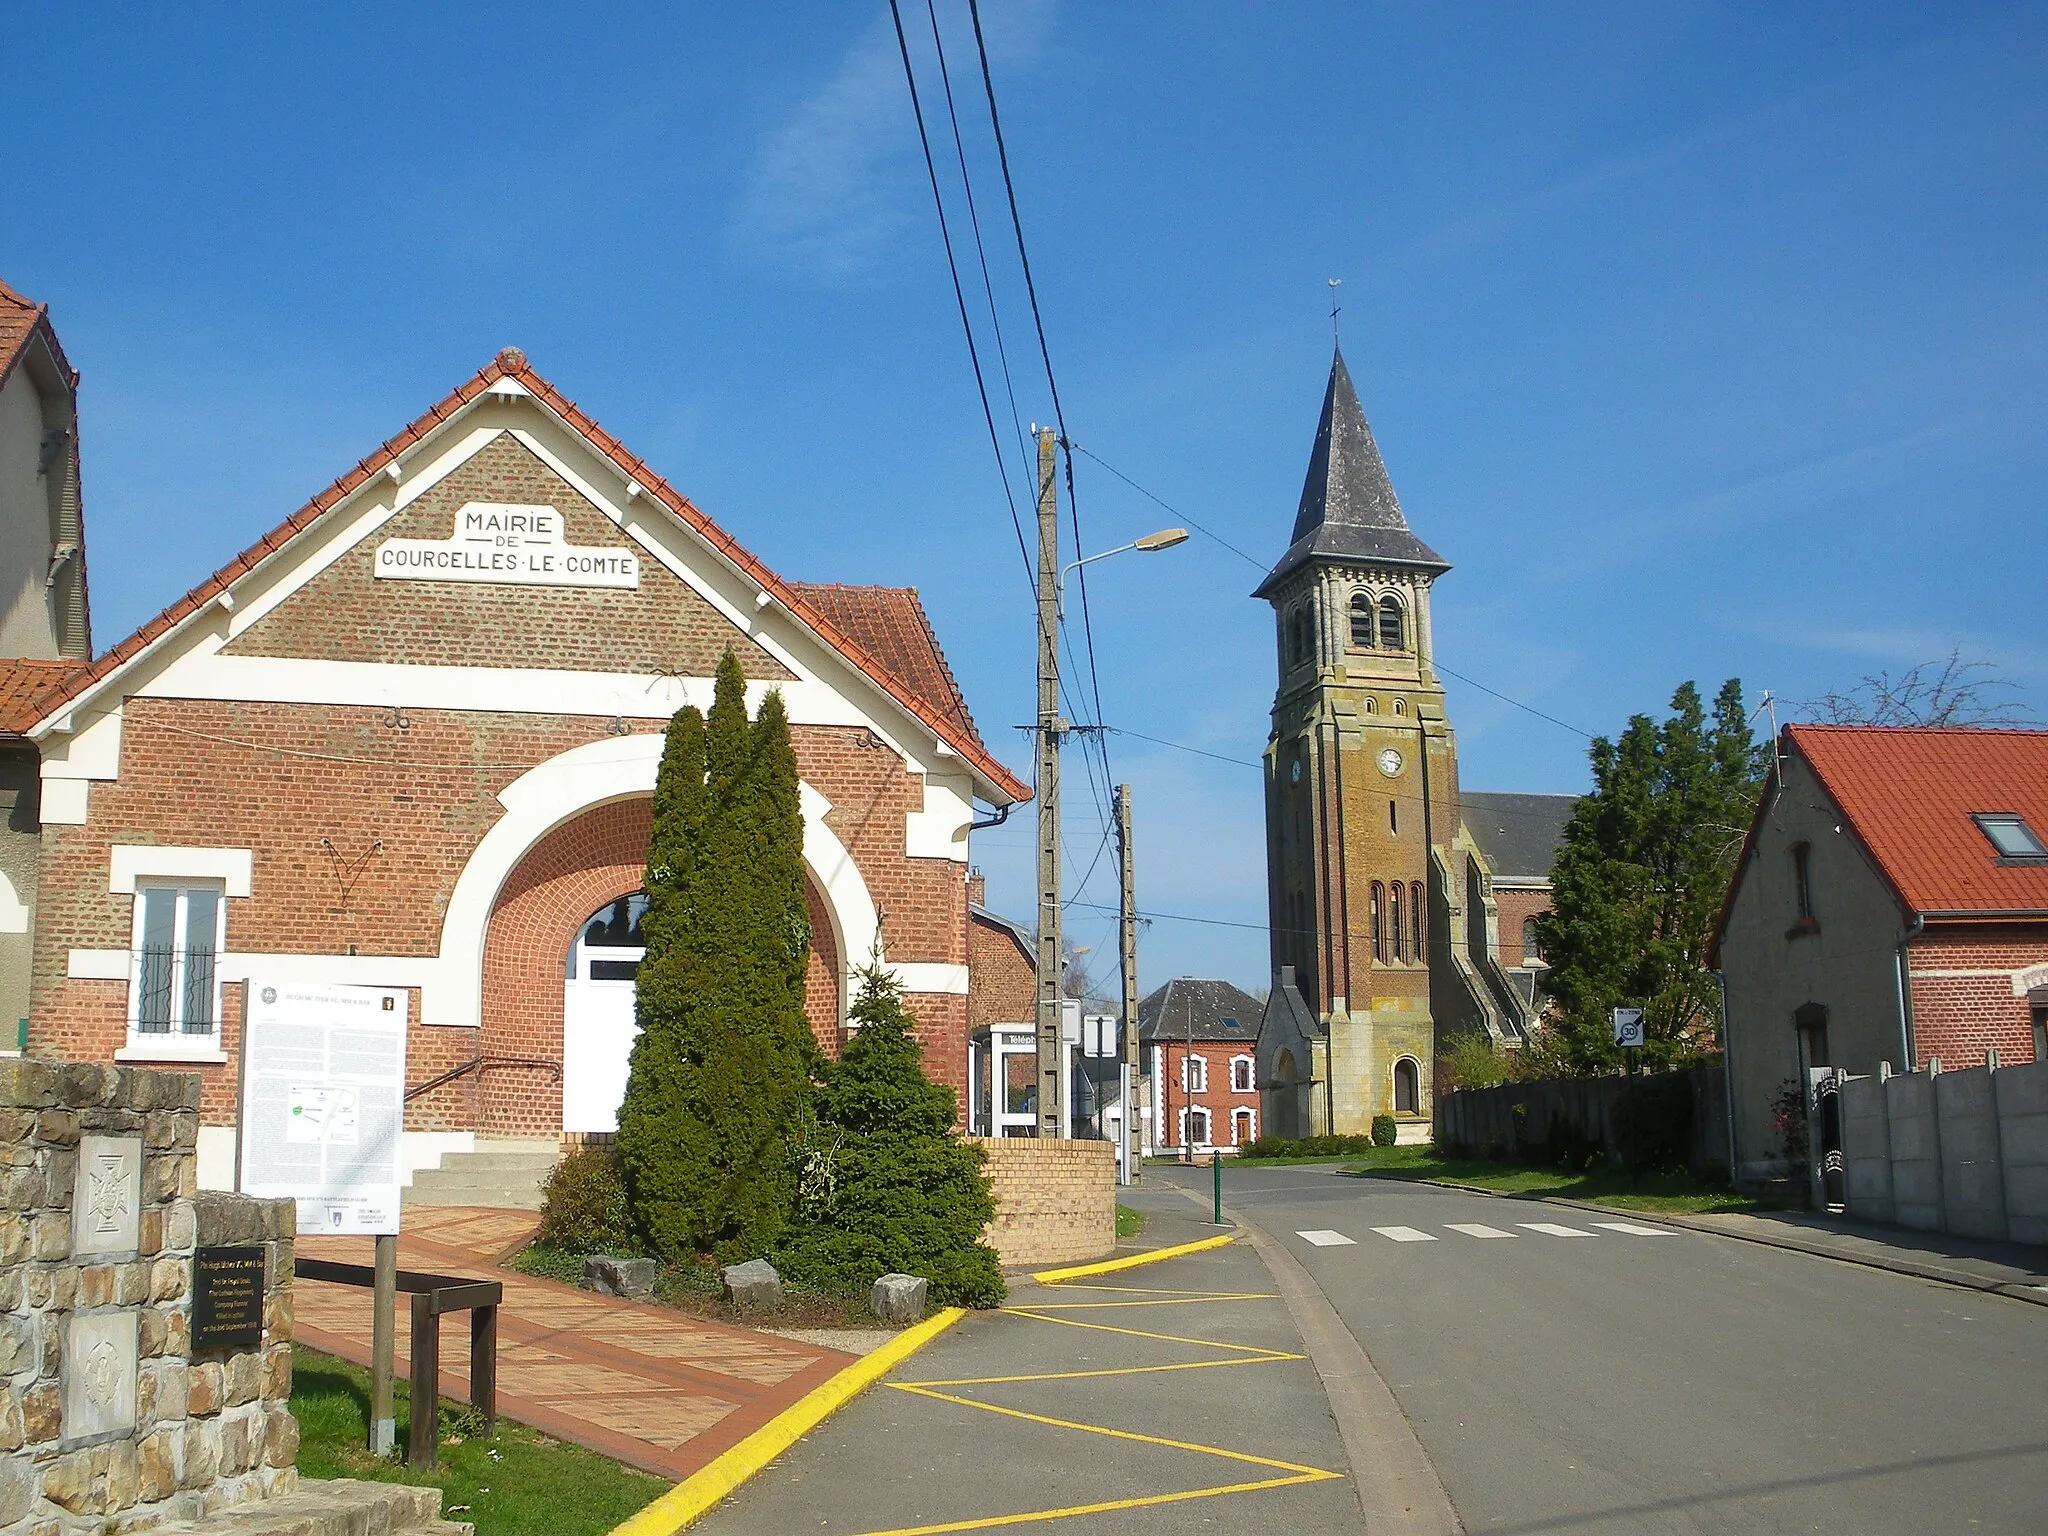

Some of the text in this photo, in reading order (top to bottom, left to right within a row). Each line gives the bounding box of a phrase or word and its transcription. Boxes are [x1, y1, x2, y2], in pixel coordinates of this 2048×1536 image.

[495, 535, 520, 548] DE
[566, 556, 633, 575] COMTE
[1624, 1027, 1635, 1036] 30
